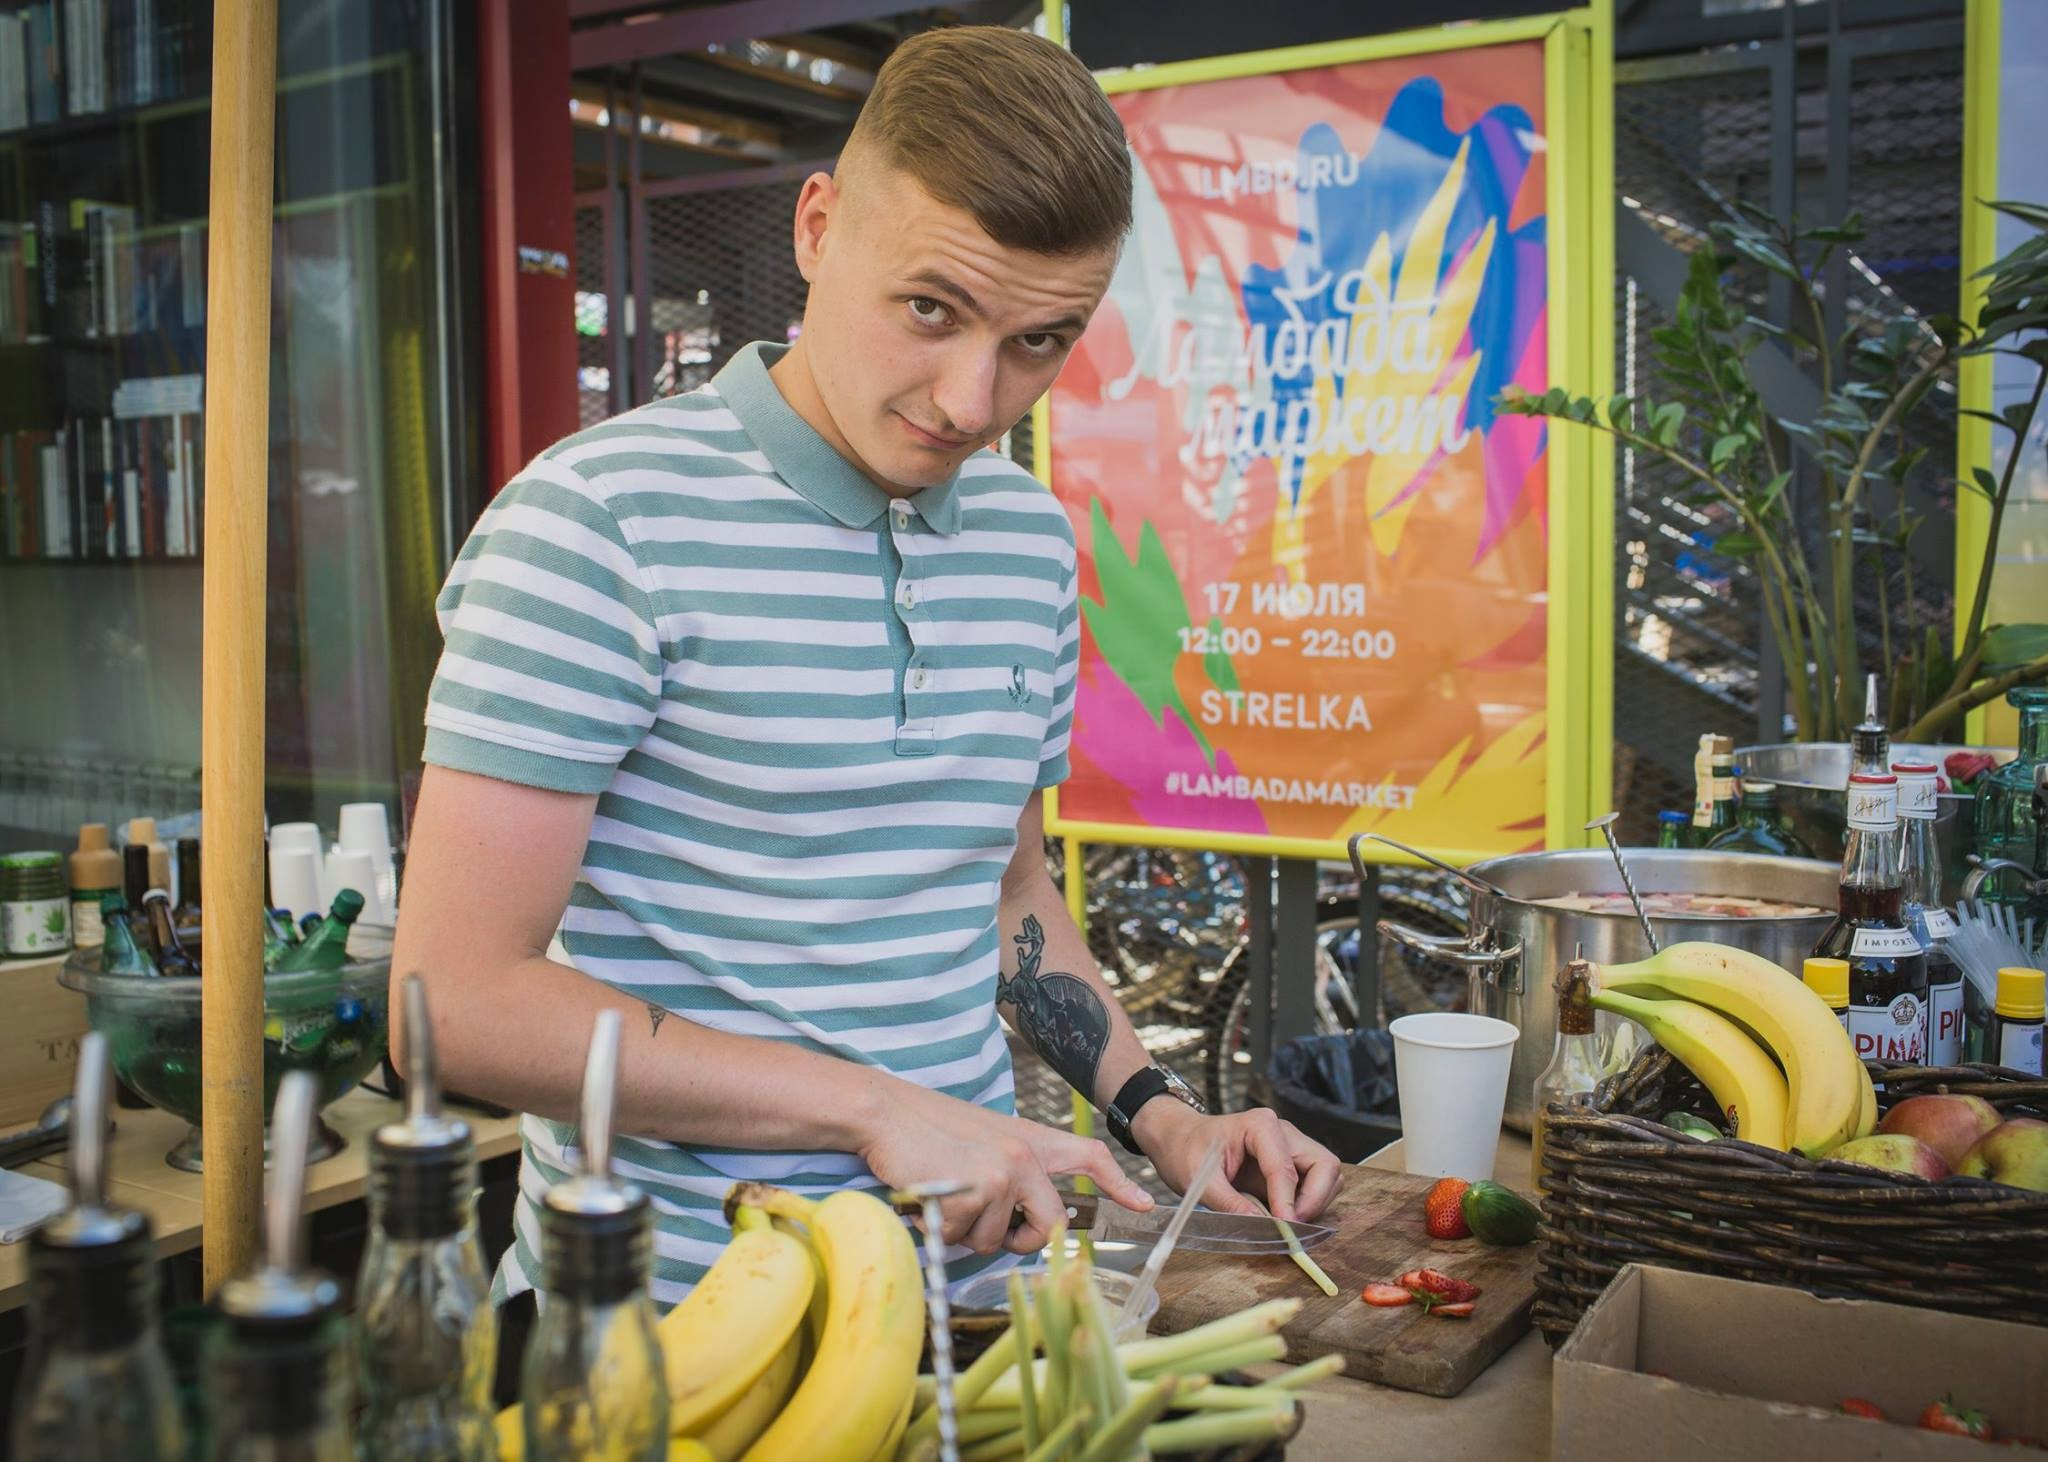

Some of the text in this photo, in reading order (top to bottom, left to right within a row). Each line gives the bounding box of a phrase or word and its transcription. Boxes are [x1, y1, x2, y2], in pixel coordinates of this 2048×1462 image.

[1202, 152, 1360, 199] LMBD.RU
[1109, 269, 1443, 399] Ламбада
[1203, 582, 1365, 617] 17 ИЮЛЯ
[1177, 627, 1262, 655] 12:00
[1301, 629, 1396, 659] 22:00
[1201, 689, 1372, 731] STRELKA
[1165, 771, 1418, 810] #LAMBADAMARKET
